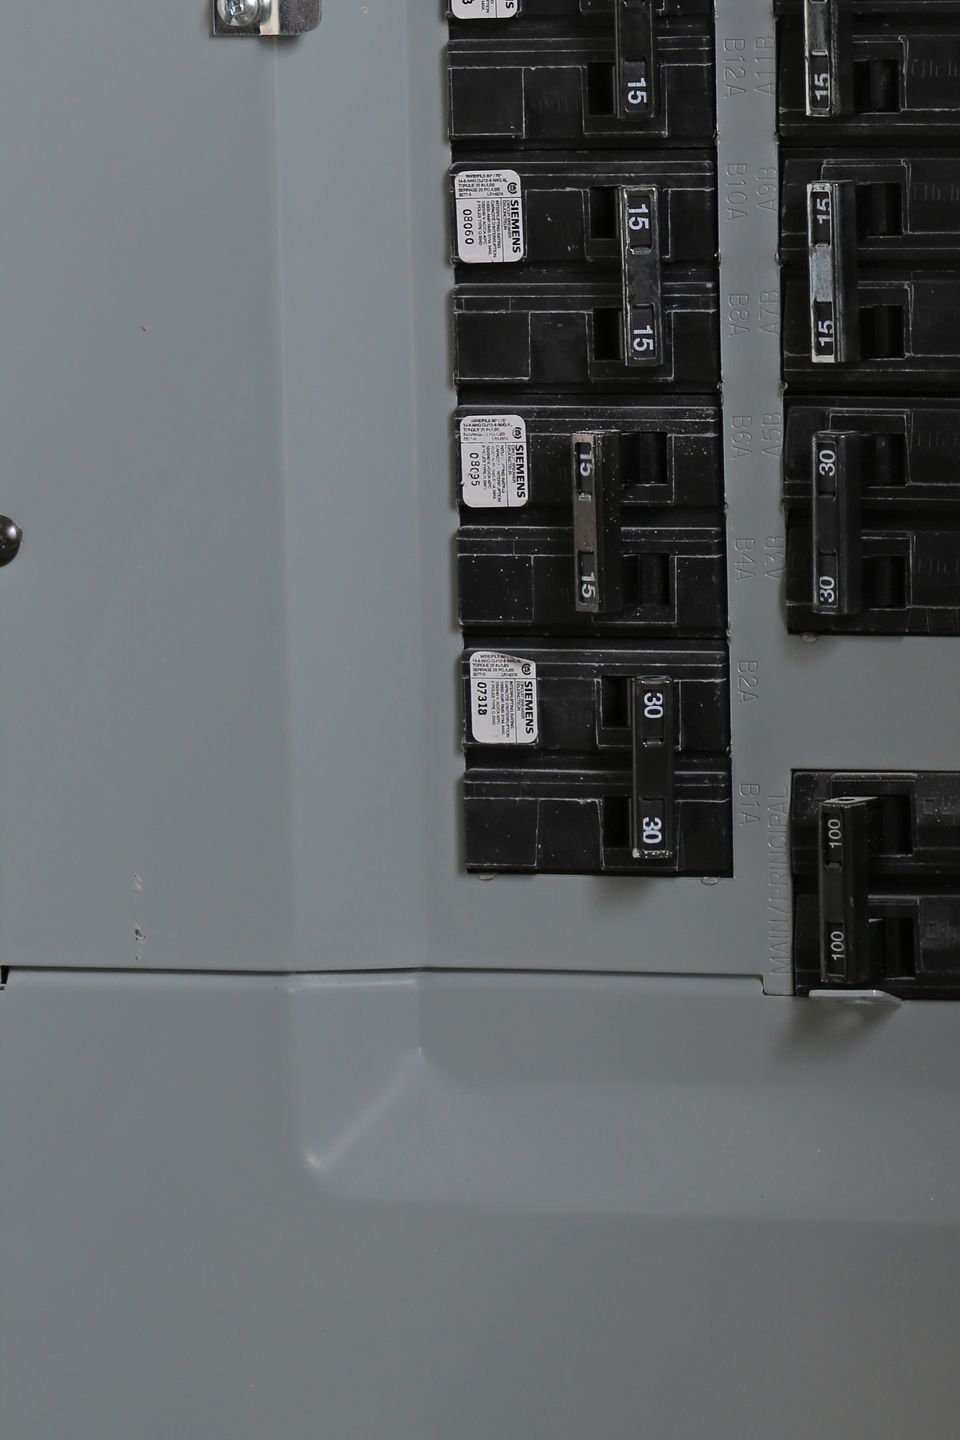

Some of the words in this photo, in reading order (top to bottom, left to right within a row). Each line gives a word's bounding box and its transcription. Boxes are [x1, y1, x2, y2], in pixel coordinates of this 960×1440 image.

[723, 38, 747, 99] B12A
[754, 36, 775, 95] A11B
[627, 77, 647, 105] 15
[814, 72, 829, 101] 15
[726, 162, 748, 222] B10A
[756, 168, 777, 212] A9B
[510, 199, 521, 254] SIEMENS
[628, 203, 649, 231] 15
[816, 198, 831, 225] 15
[727, 293, 750, 338] B8A
[759, 290, 780, 336] A7B
[633, 325, 654, 352] 15
[818, 320, 834, 346] 15
[731, 415, 753, 460] B6A
[515, 444, 526, 498] SIEMENS
[579, 451, 592, 477] 15
[819, 450, 835, 477] 30
[734, 538, 756, 583] B4A
[581, 571, 596, 598] 15
[819, 576, 835, 603] 30
[738, 660, 759, 704] B2A
[477, 682, 488, 716] 07318
[524, 680, 534, 734] SIEMENS
[644, 692, 663, 719] 30
[739, 783, 760, 826] B1A
[642, 817, 662, 844] 30
[828, 818, 842, 849] 100
[830, 931, 845, 961] 100
